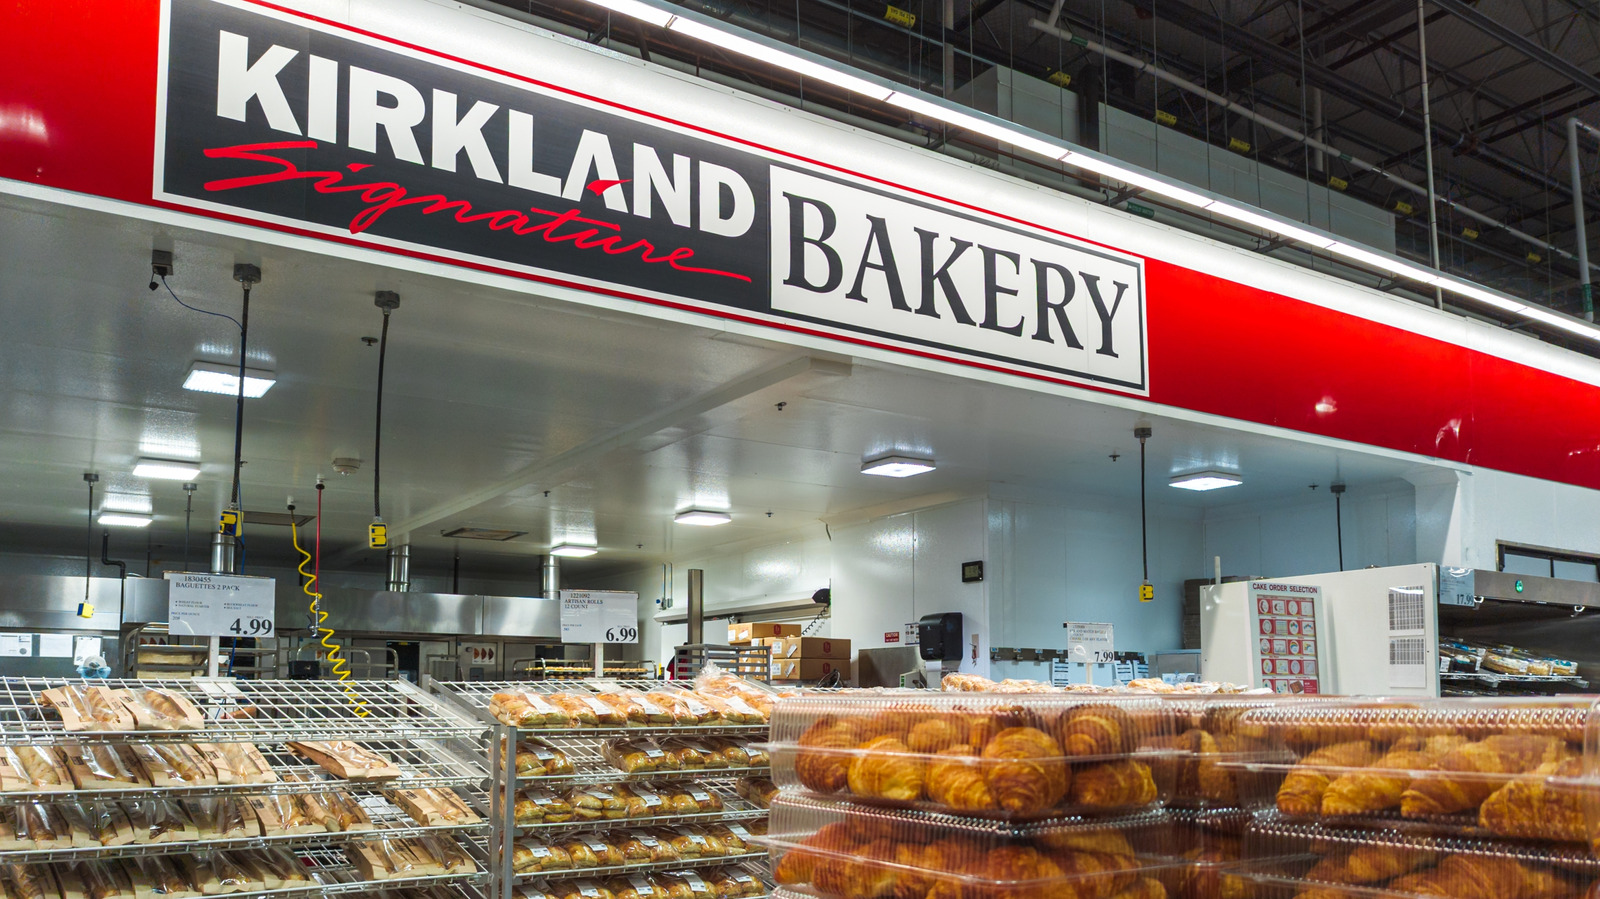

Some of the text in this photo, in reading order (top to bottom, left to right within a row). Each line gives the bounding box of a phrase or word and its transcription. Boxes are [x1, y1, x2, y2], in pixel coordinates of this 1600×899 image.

[216, 31, 756, 238] KIRKLAND
[203, 140, 752, 283] Signature
[782, 191, 1129, 359] BAKERY
[1252, 582, 1318, 594] CAKE ORDER SELECTION
[1457, 594, 1474, 605] 17.99
[230, 618, 272, 635] 4.99
[606, 627, 637, 642] 6.99
[1095, 651, 1114, 662] 7.99
